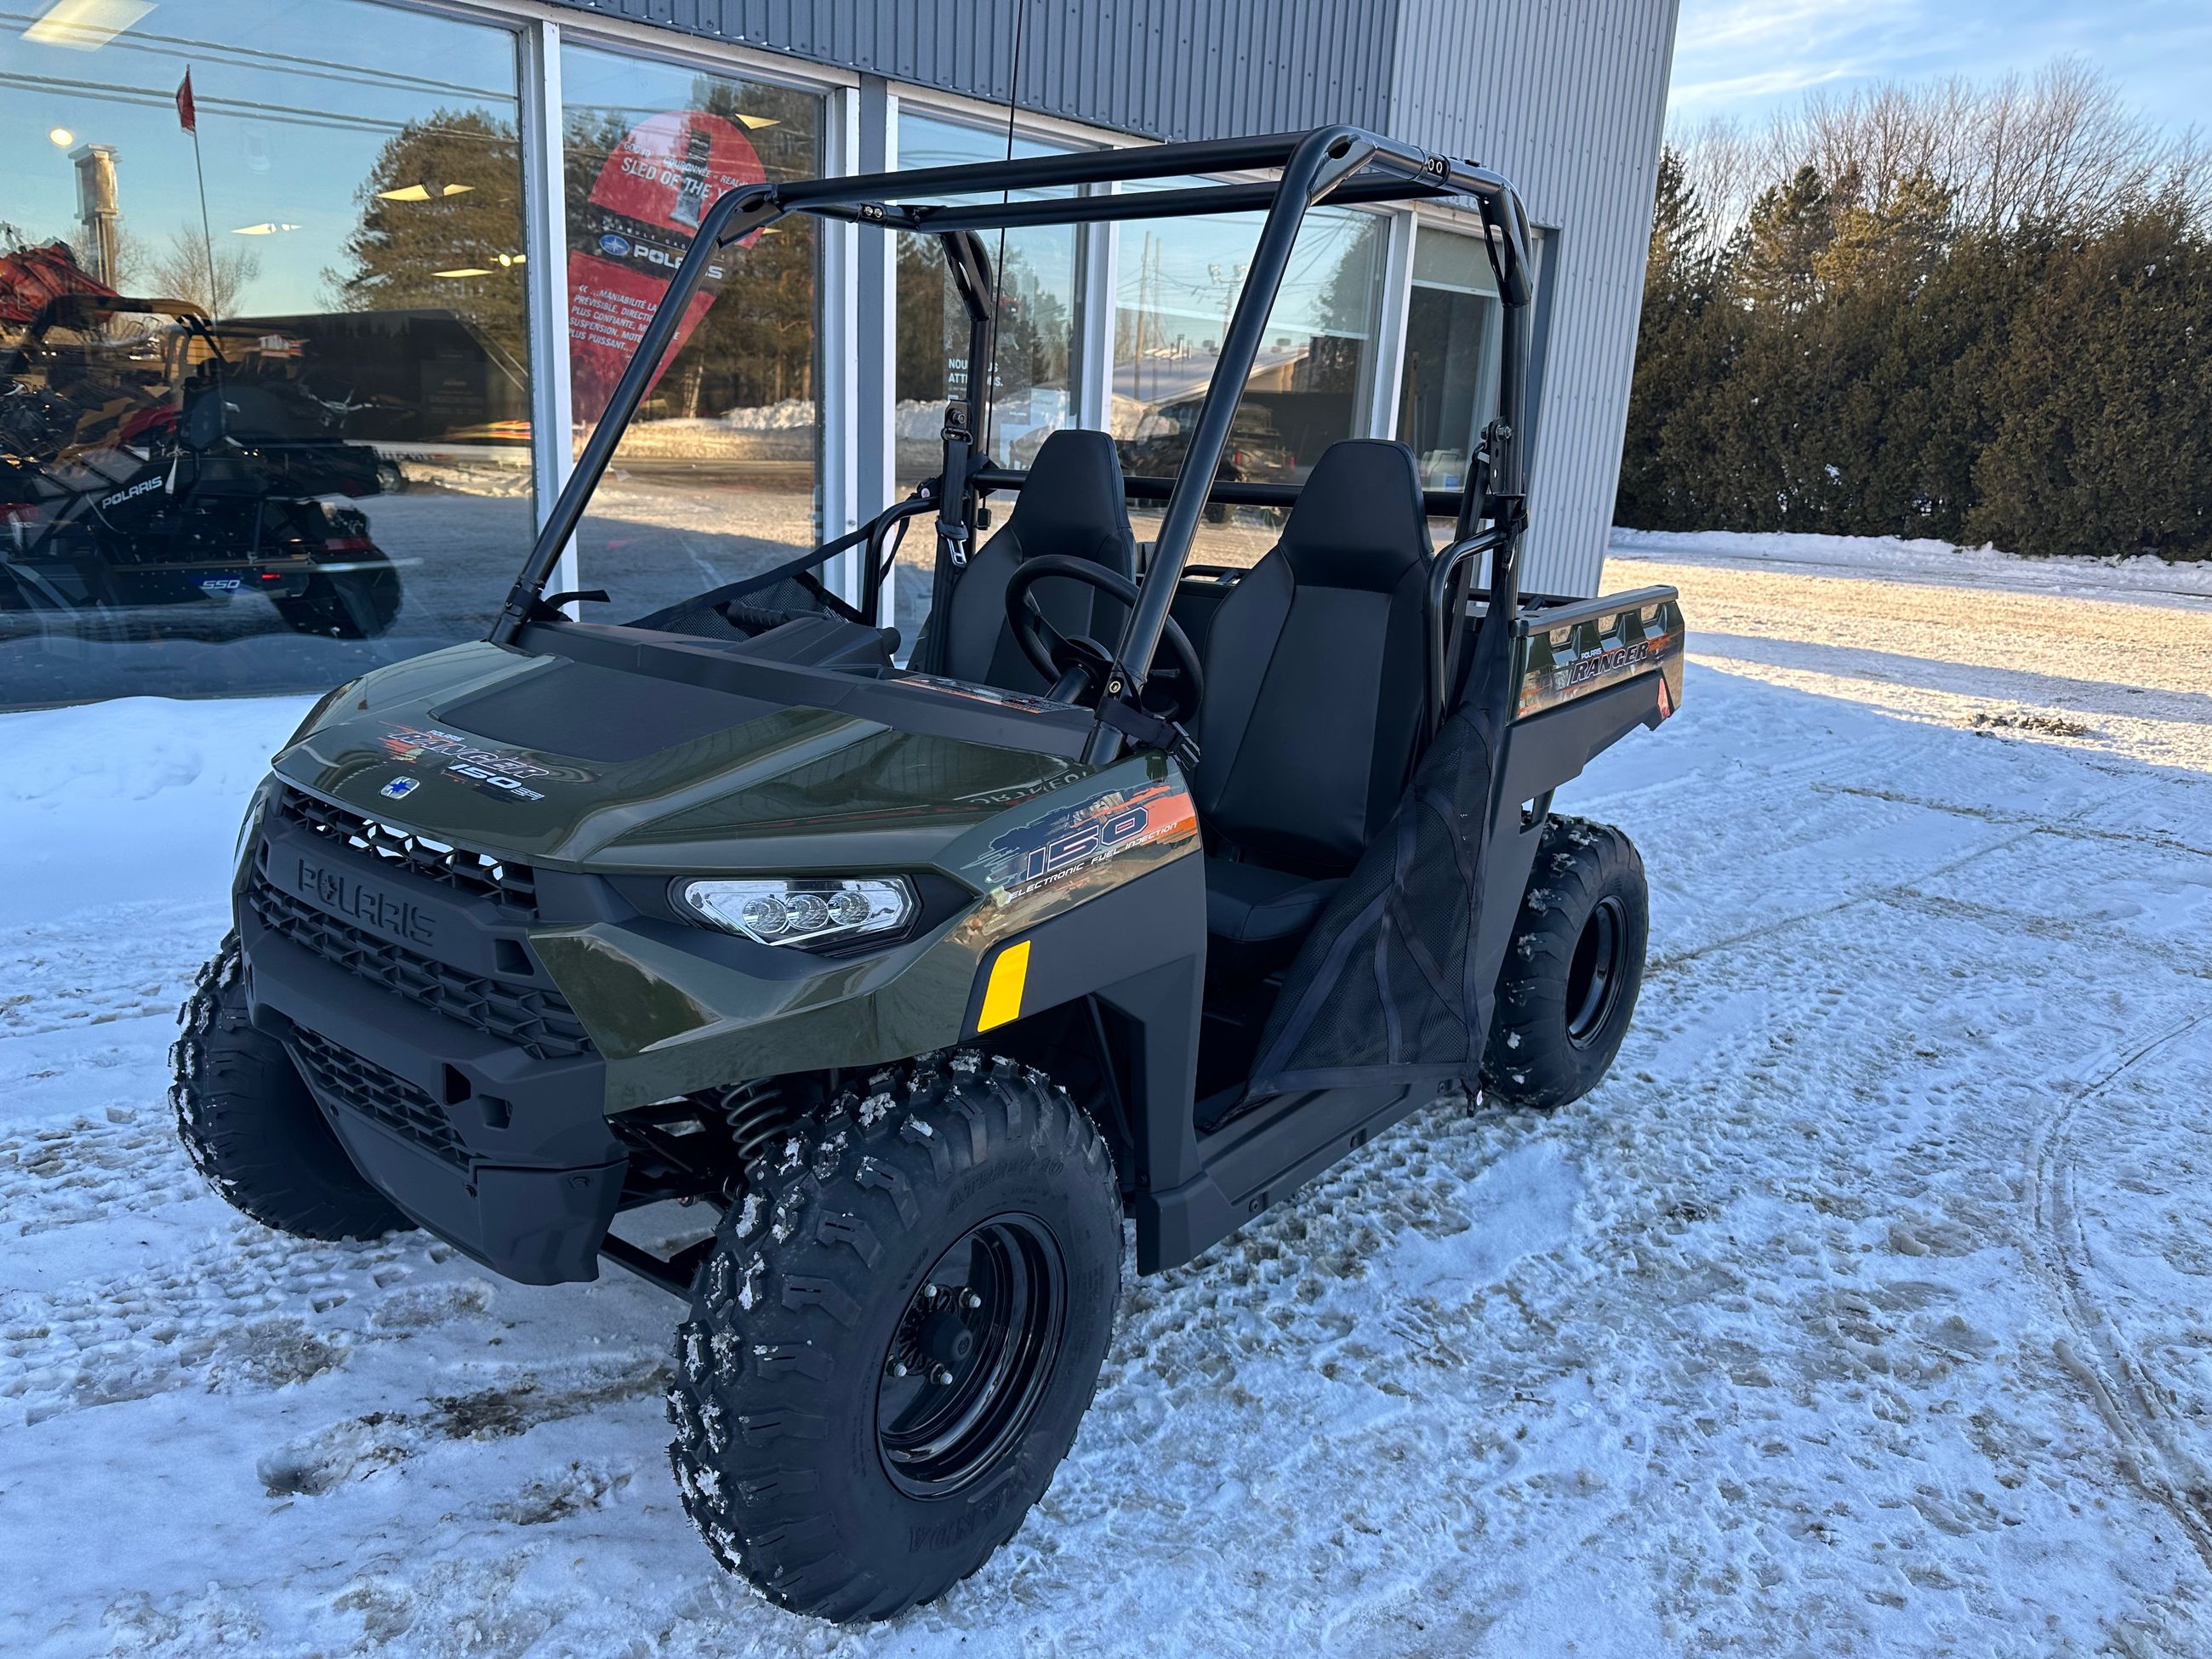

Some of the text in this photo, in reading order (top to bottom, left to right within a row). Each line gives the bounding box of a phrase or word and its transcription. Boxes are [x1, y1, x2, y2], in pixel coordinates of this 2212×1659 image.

[621, 157, 657, 180] SLED
[660, 170, 681, 187] OF
[681, 178, 713, 199] THE
[571, 305, 591, 317] PLUS
[948, 358, 968, 370] NOU
[102, 476, 163, 509] POLARIS
[1571, 641, 1650, 684] RANGER
[1581, 647, 1602, 660] POLARIS
[428, 729, 465, 742] POLARIS
[387, 731, 550, 778] RANGER
[448, 763, 522, 790] 150
[1010, 821, 1178, 900] ELECTRONIC FUEL INJECTION
[1026, 807, 1149, 881] 150
[298, 858, 436, 947] POLARIS
